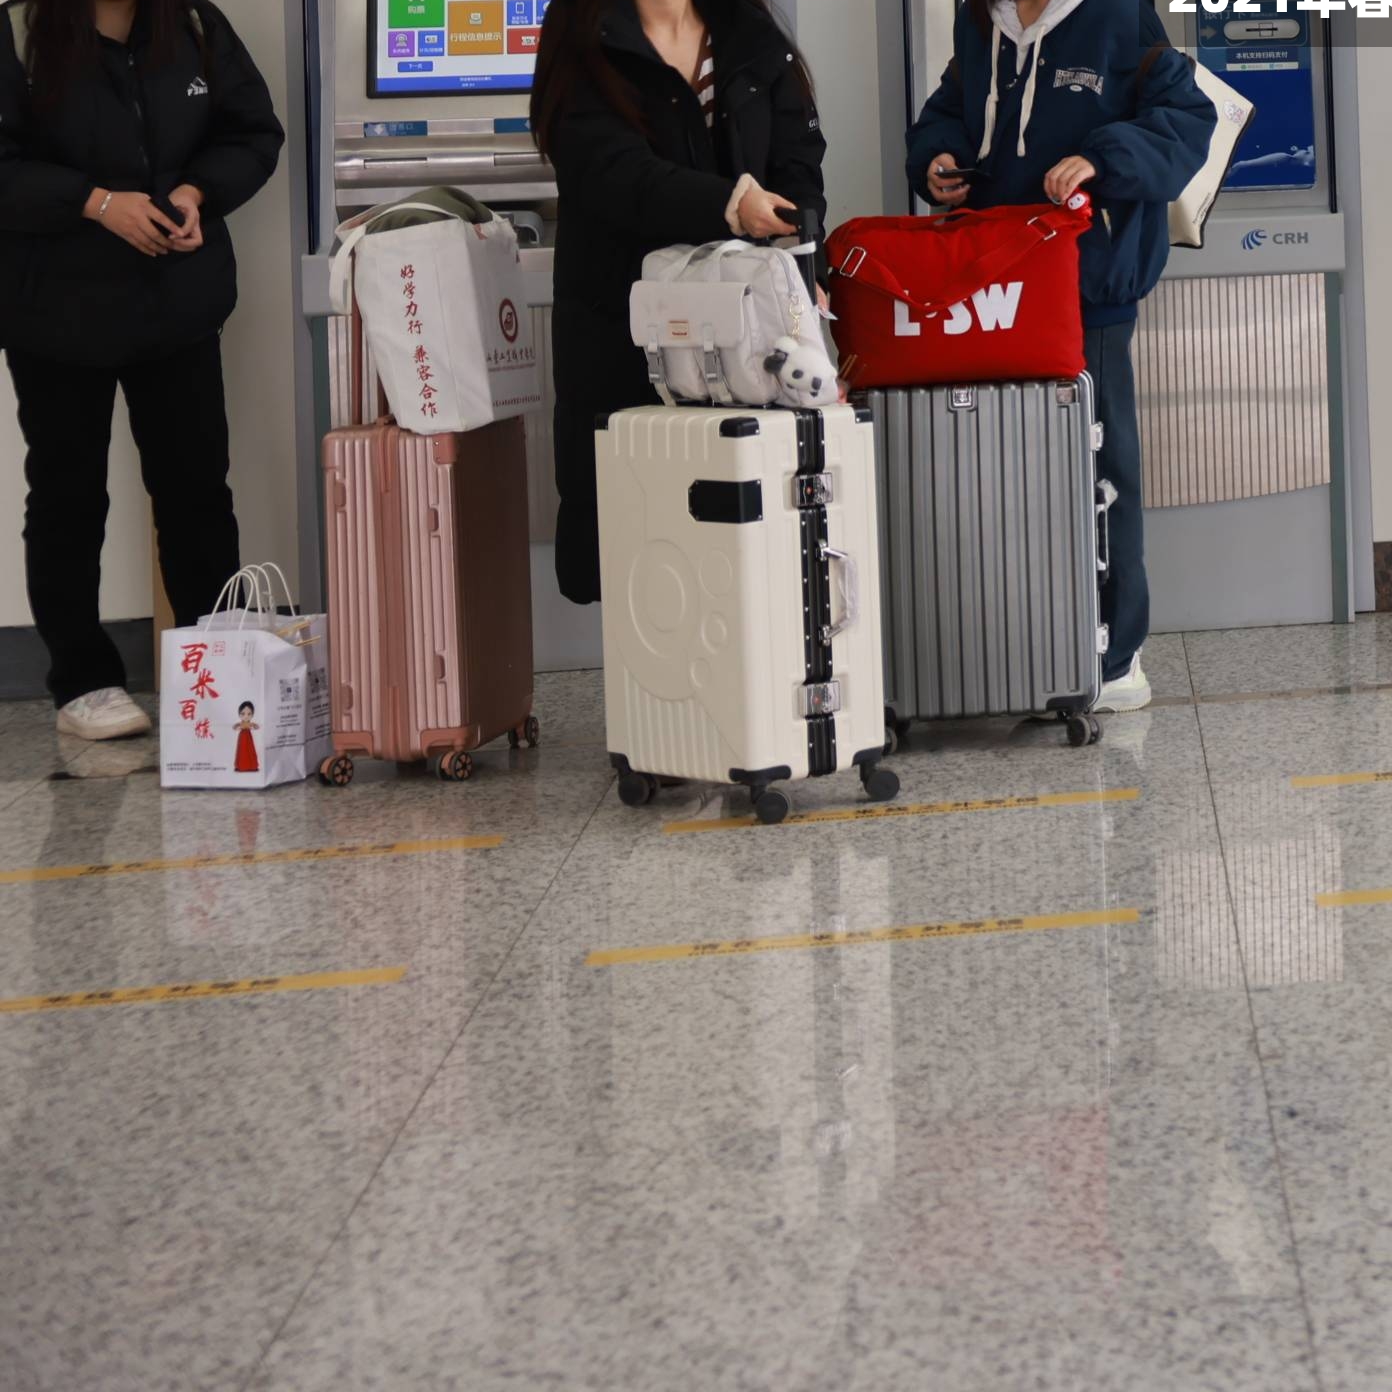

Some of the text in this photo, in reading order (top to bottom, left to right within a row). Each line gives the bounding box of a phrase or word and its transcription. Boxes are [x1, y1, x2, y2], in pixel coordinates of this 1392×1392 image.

[1272, 232, 1309, 245] CRH
[400, 264, 438, 418] 好学力行 兼容合作
